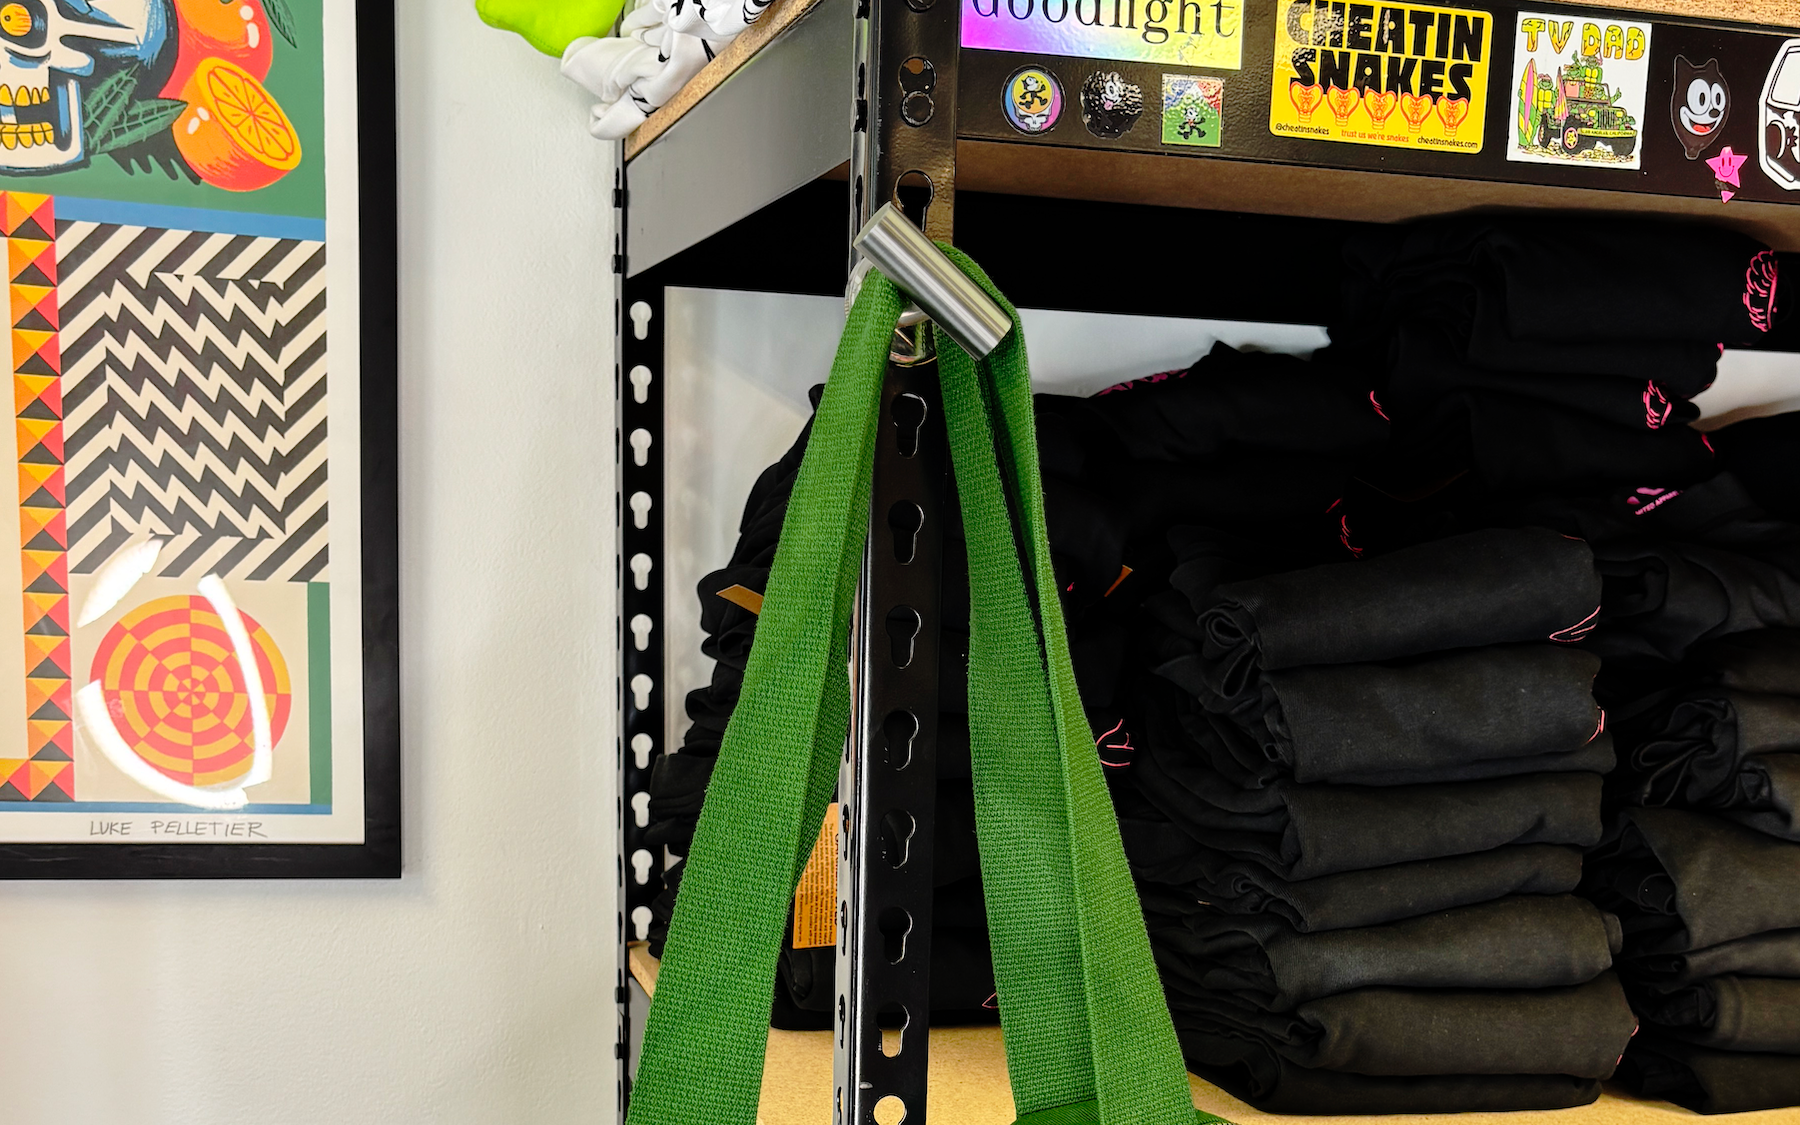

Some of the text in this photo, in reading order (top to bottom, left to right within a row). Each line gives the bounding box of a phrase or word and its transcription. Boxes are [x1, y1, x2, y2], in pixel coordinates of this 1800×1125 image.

[1286, 0, 1484, 63] CHEATIN
[1520, 18, 1646, 60] TV DAD
[1289, 47, 1474, 106] SNAKES
[1274, 122, 1331, 137] @cheatinsnakes
[1340, 129, 1410, 144] trust us we're snakes
[1416, 136, 1479, 150] cheatinsnakes.com
[89, 820, 269, 838] LUKE PELLETIER
